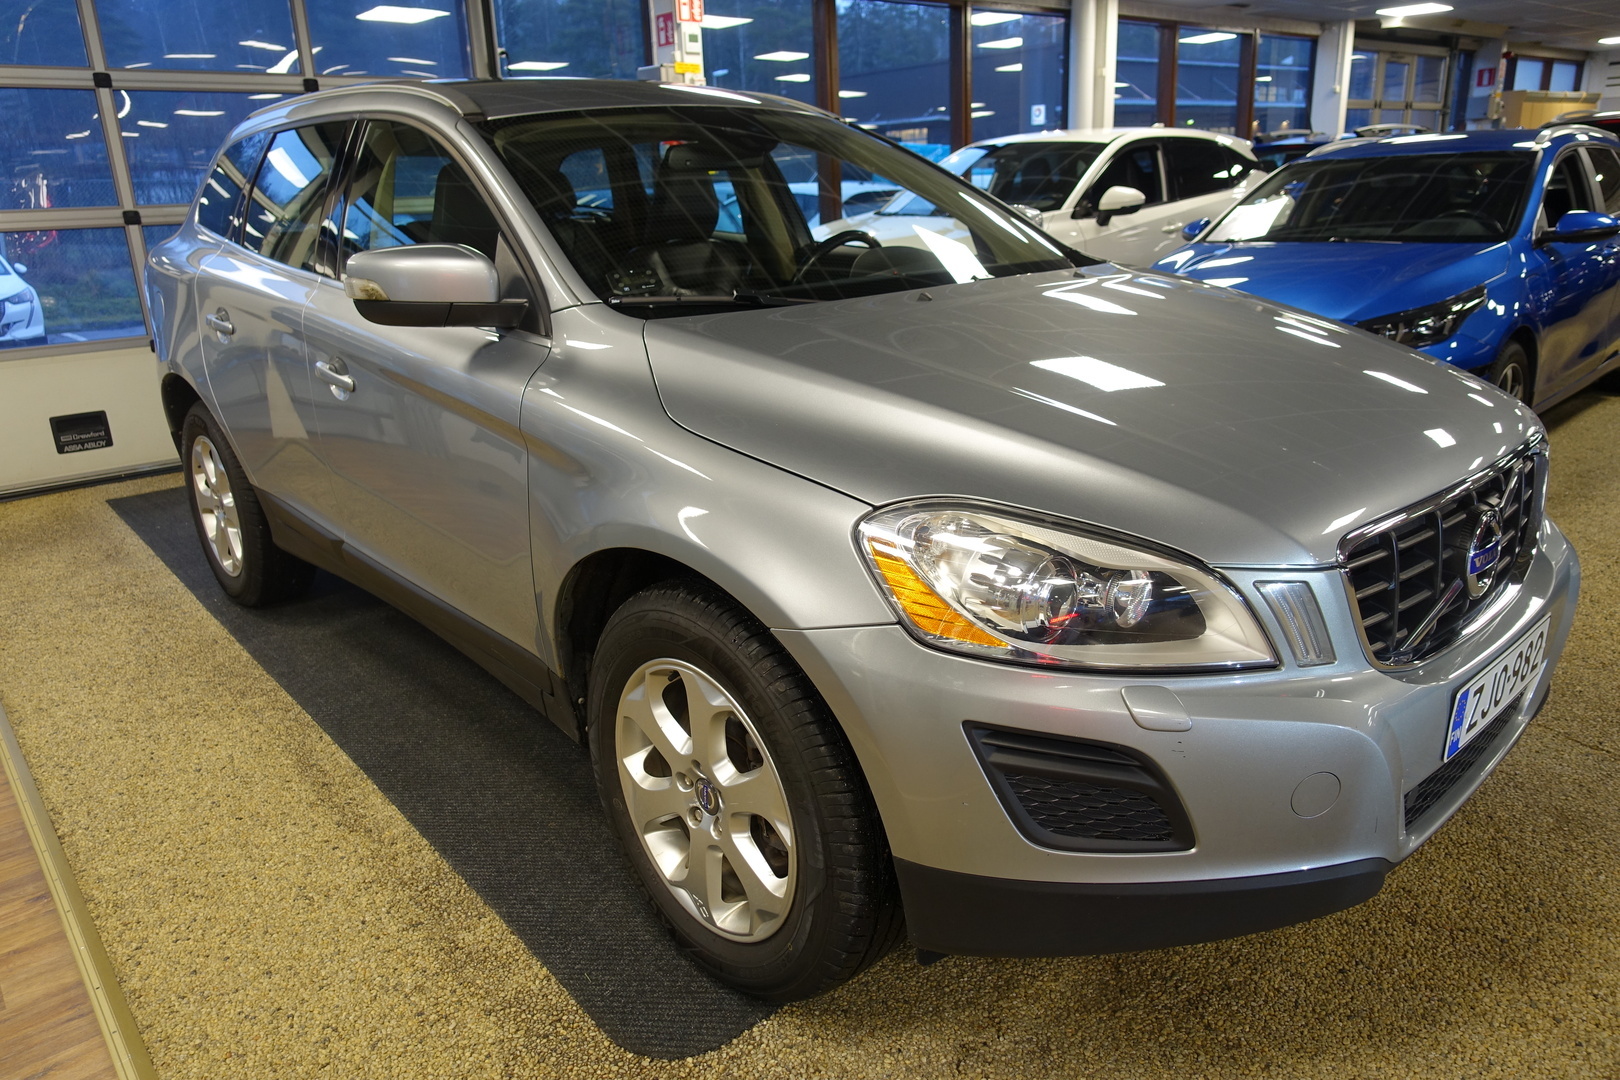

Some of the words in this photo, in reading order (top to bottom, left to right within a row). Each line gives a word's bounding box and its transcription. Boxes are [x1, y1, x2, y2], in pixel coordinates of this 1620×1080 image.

[64, 444, 84, 453] ASSA
[83, 440, 106, 450] ABLOY
[1465, 630, 1544, 735] ZJO-982
[1450, 725, 1462, 746] FIN
